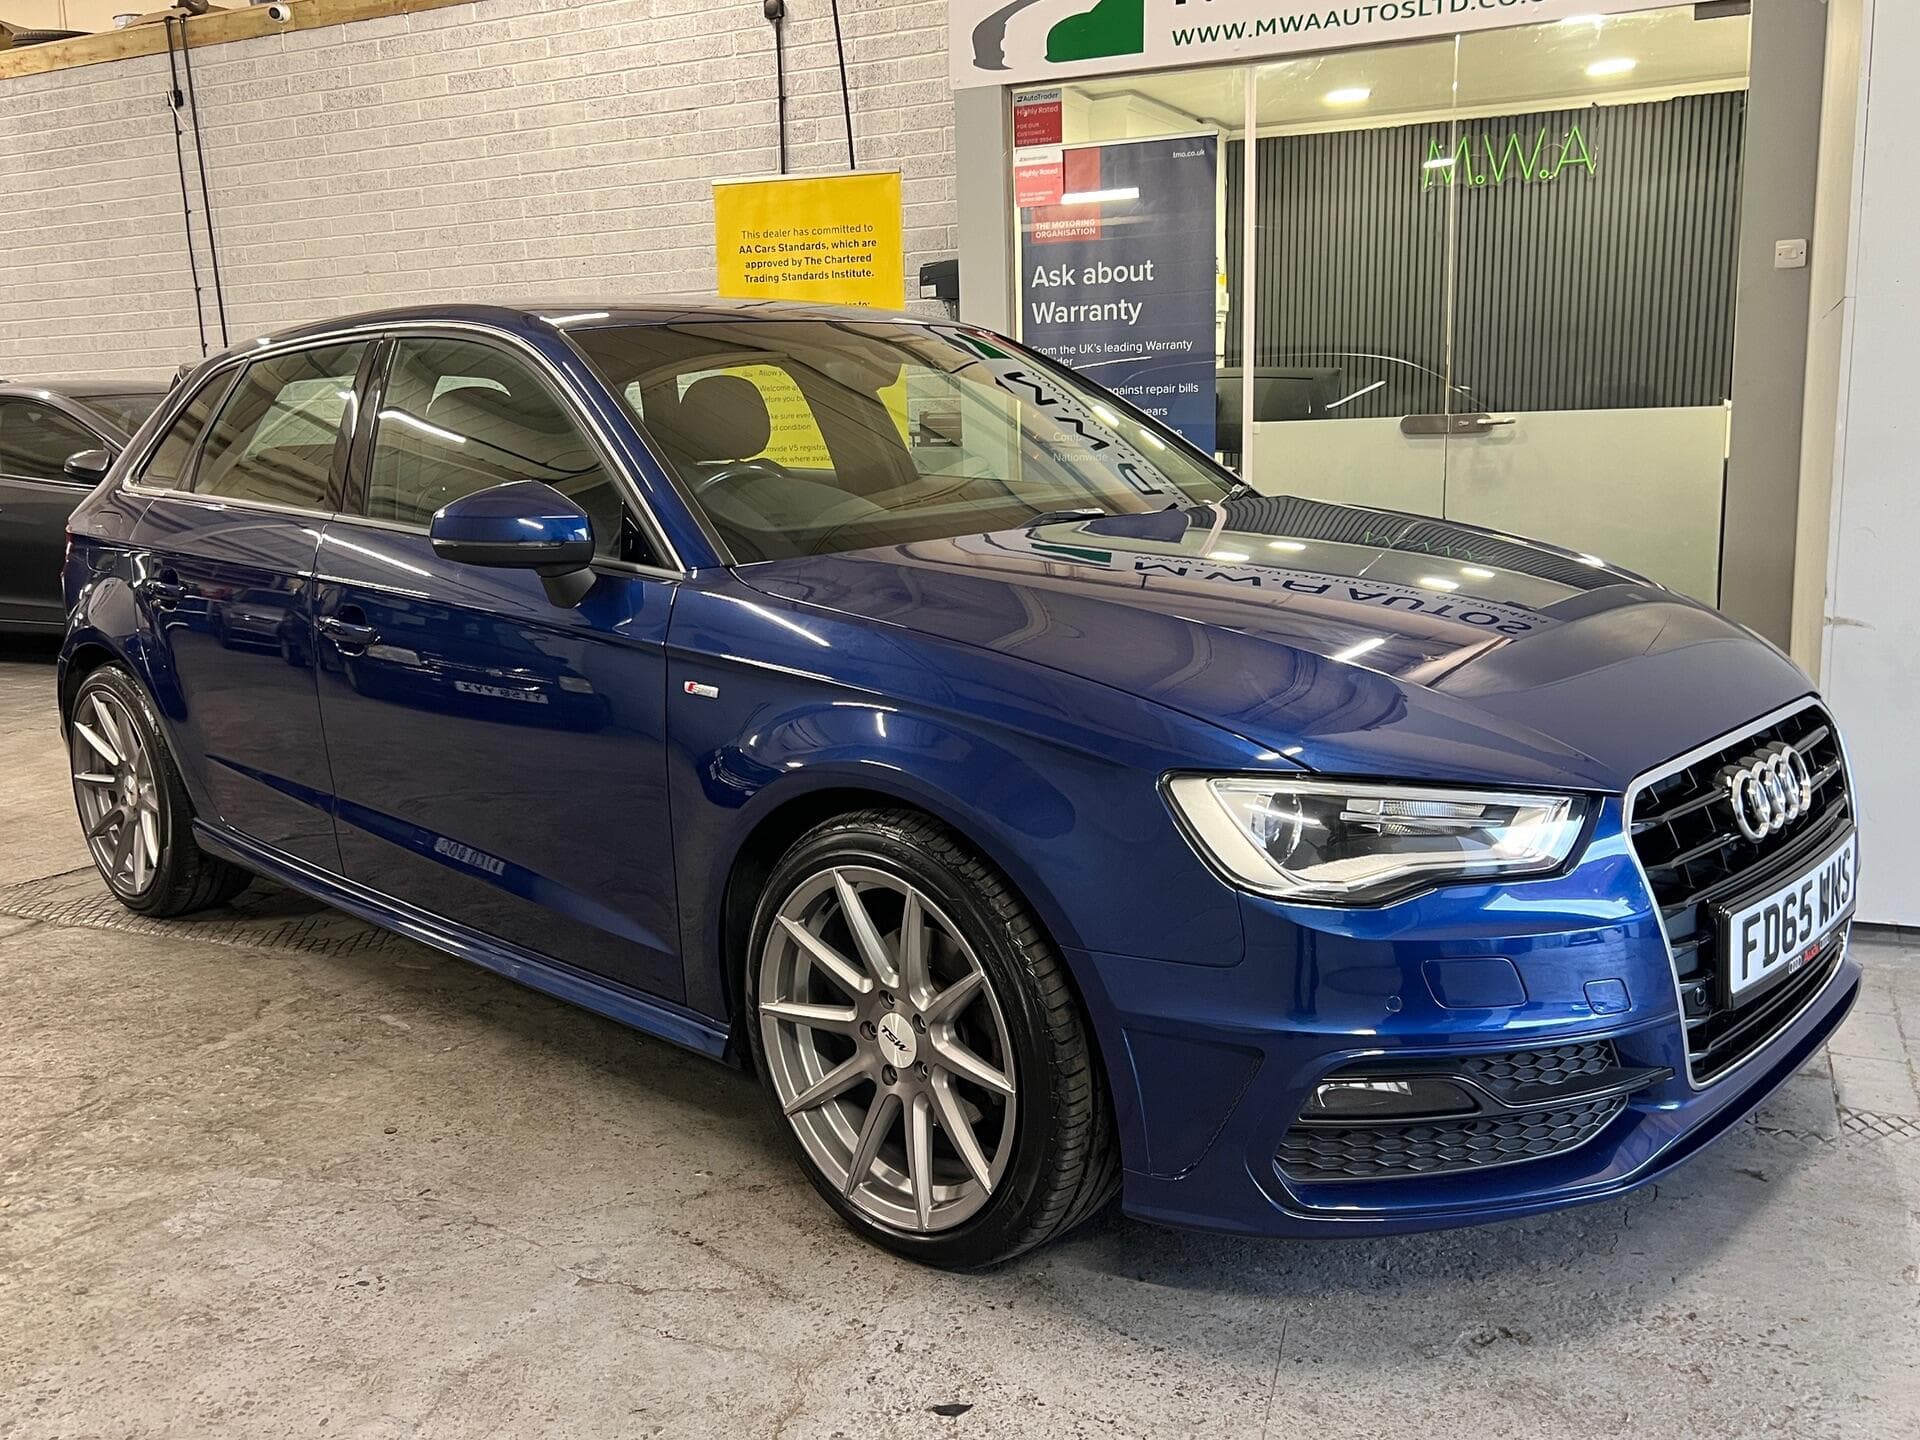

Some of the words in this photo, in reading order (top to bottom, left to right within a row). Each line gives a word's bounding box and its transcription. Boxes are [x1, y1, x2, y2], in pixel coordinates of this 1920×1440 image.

[1172, 149, 1205, 159] tmo.co.uk
[1422, 122, 1595, 190] M.W.A
[741, 230, 761, 240] This
[762, 228, 791, 239] dealer
[793, 227, 810, 237] has
[811, 224, 862, 236] committed
[863, 224, 874, 233] to
[1035, 222, 1051, 230] THE
[1051, 218, 1096, 229] MOTORING
[1035, 227, 1096, 239] ORGANISATION
[738, 244, 753, 254] AA
[754, 243, 776, 254] Cars
[778, 240, 829, 252] Standards,
[831, 238, 859, 249] which
[861, 238, 877, 248] are
[745, 258, 789, 271] approved
[791, 257, 802, 268] by
[804, 255, 822, 266] The
[824, 253, 872, 264] Chartered
[744, 273, 779, 284] Trading
[781, 271, 829, 282] Standards
[831, 268, 875, 279] Institute.
[1031, 263, 1076, 288] Ask
[1082, 259, 1154, 284] about
[1031, 299, 1143, 325] Warranty
[1060, 344, 1076, 355] the
[1079, 343, 1102, 354] UK's
[1104, 341, 1143, 353] leading
[1146, 339, 1193, 351] Warranty
[760, 384, 791, 392] Welcome
[1146, 383, 1176, 396] repair
[1178, 382, 1199, 394] bills
[1741, 878, 1814, 981] FD65
[1818, 846, 1851, 929] WNS
[881, 1024, 913, 1053] TSW
